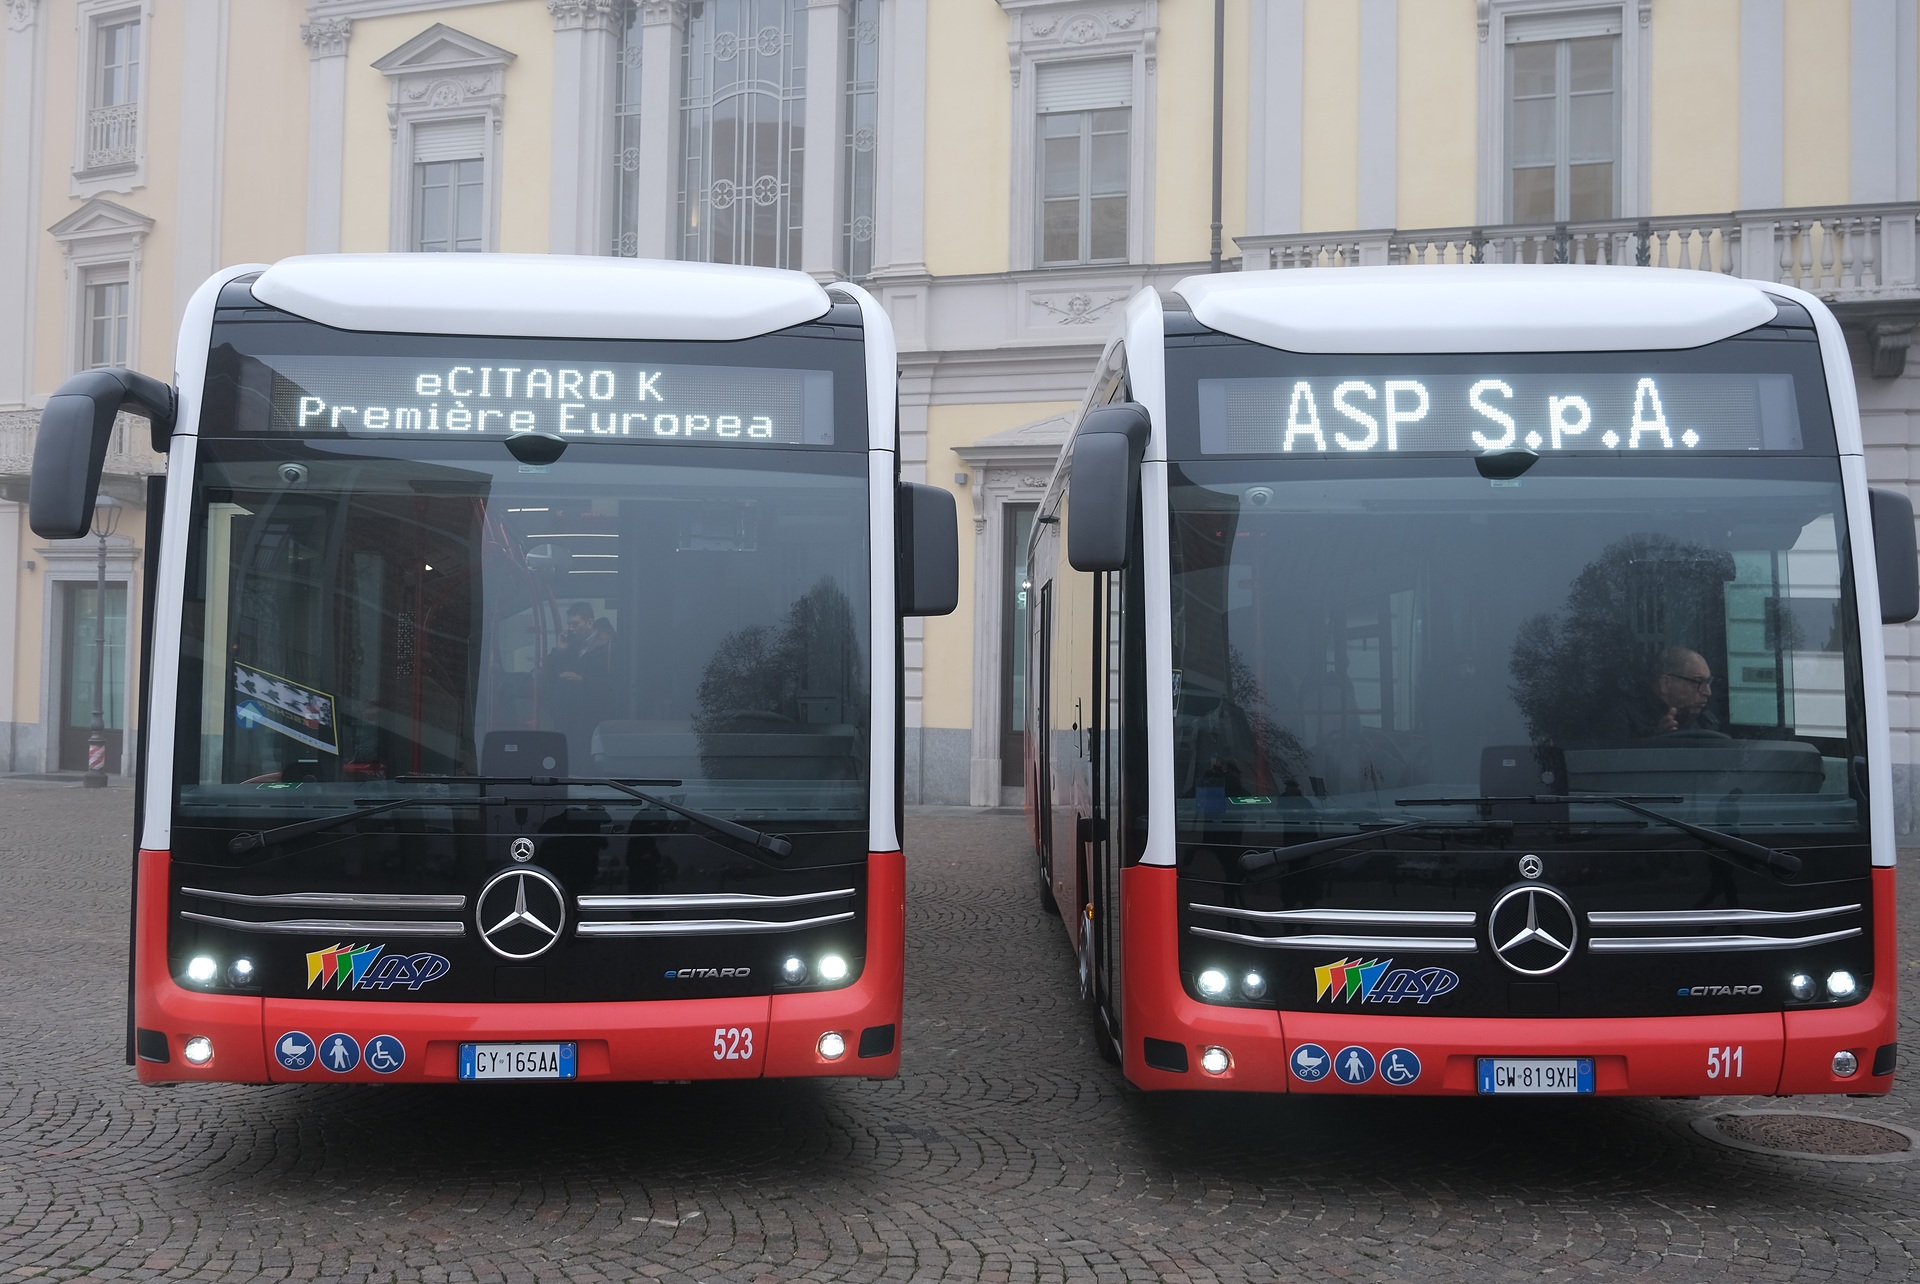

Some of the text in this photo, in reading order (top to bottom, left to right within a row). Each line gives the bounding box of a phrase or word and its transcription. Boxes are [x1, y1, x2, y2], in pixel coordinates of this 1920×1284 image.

[415, 366, 664, 402] eCITARO K
[298, 396, 774, 438] Première Europea
[1283, 378, 1700, 451] ASP S.p.A.
[359, 952, 451, 990] ASP
[664, 967, 751, 979] eCITARO
[1368, 967, 1459, 1004] ASP
[1677, 985, 1763, 997] eCITARO
[713, 1028, 754, 1060] 523
[1707, 1046, 1743, 1079] 511
